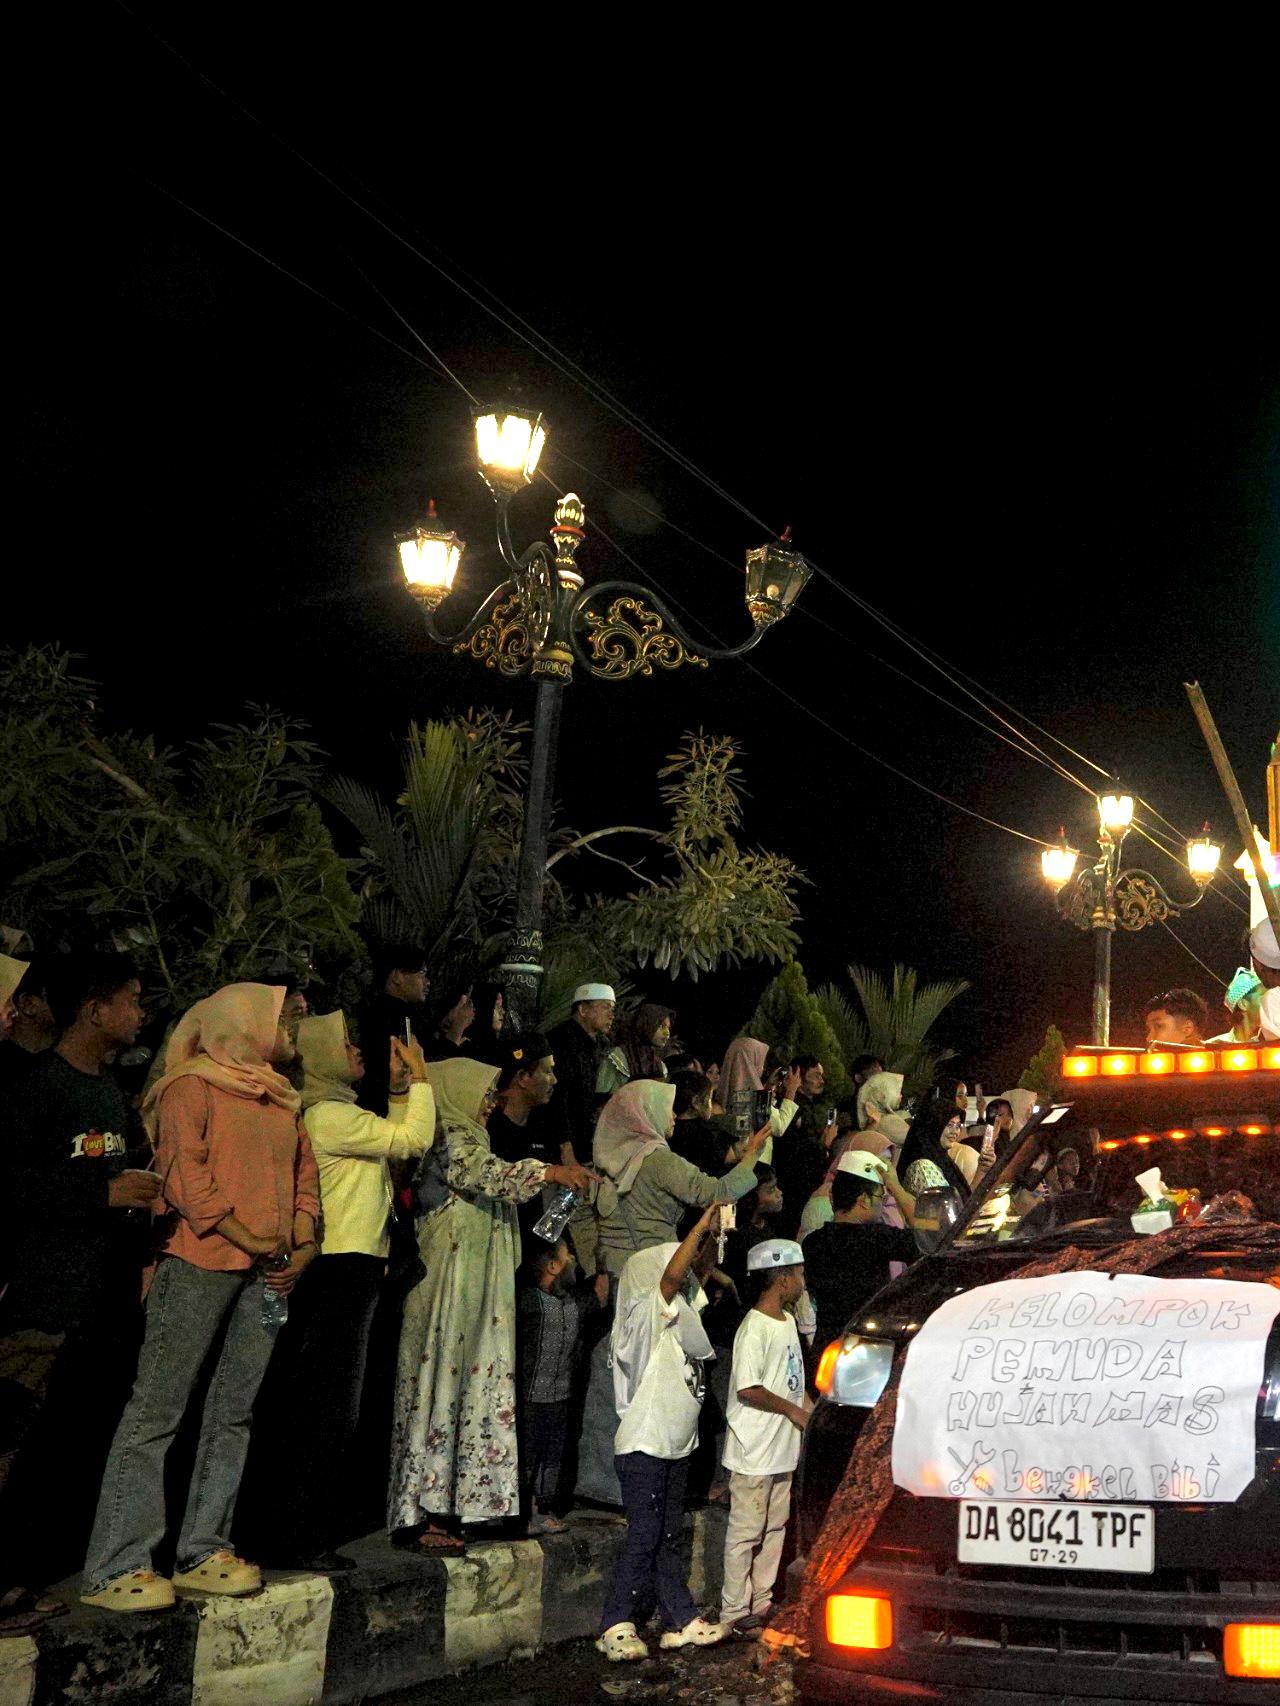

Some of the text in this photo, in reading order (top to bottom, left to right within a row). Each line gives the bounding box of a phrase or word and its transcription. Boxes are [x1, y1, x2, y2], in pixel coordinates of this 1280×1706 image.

[968, 1292, 1251, 1331] KELOMPOK
[952, 1336, 1188, 1383] PEMUDA
[966, 1505, 1146, 1548] DA 8041 TPF
